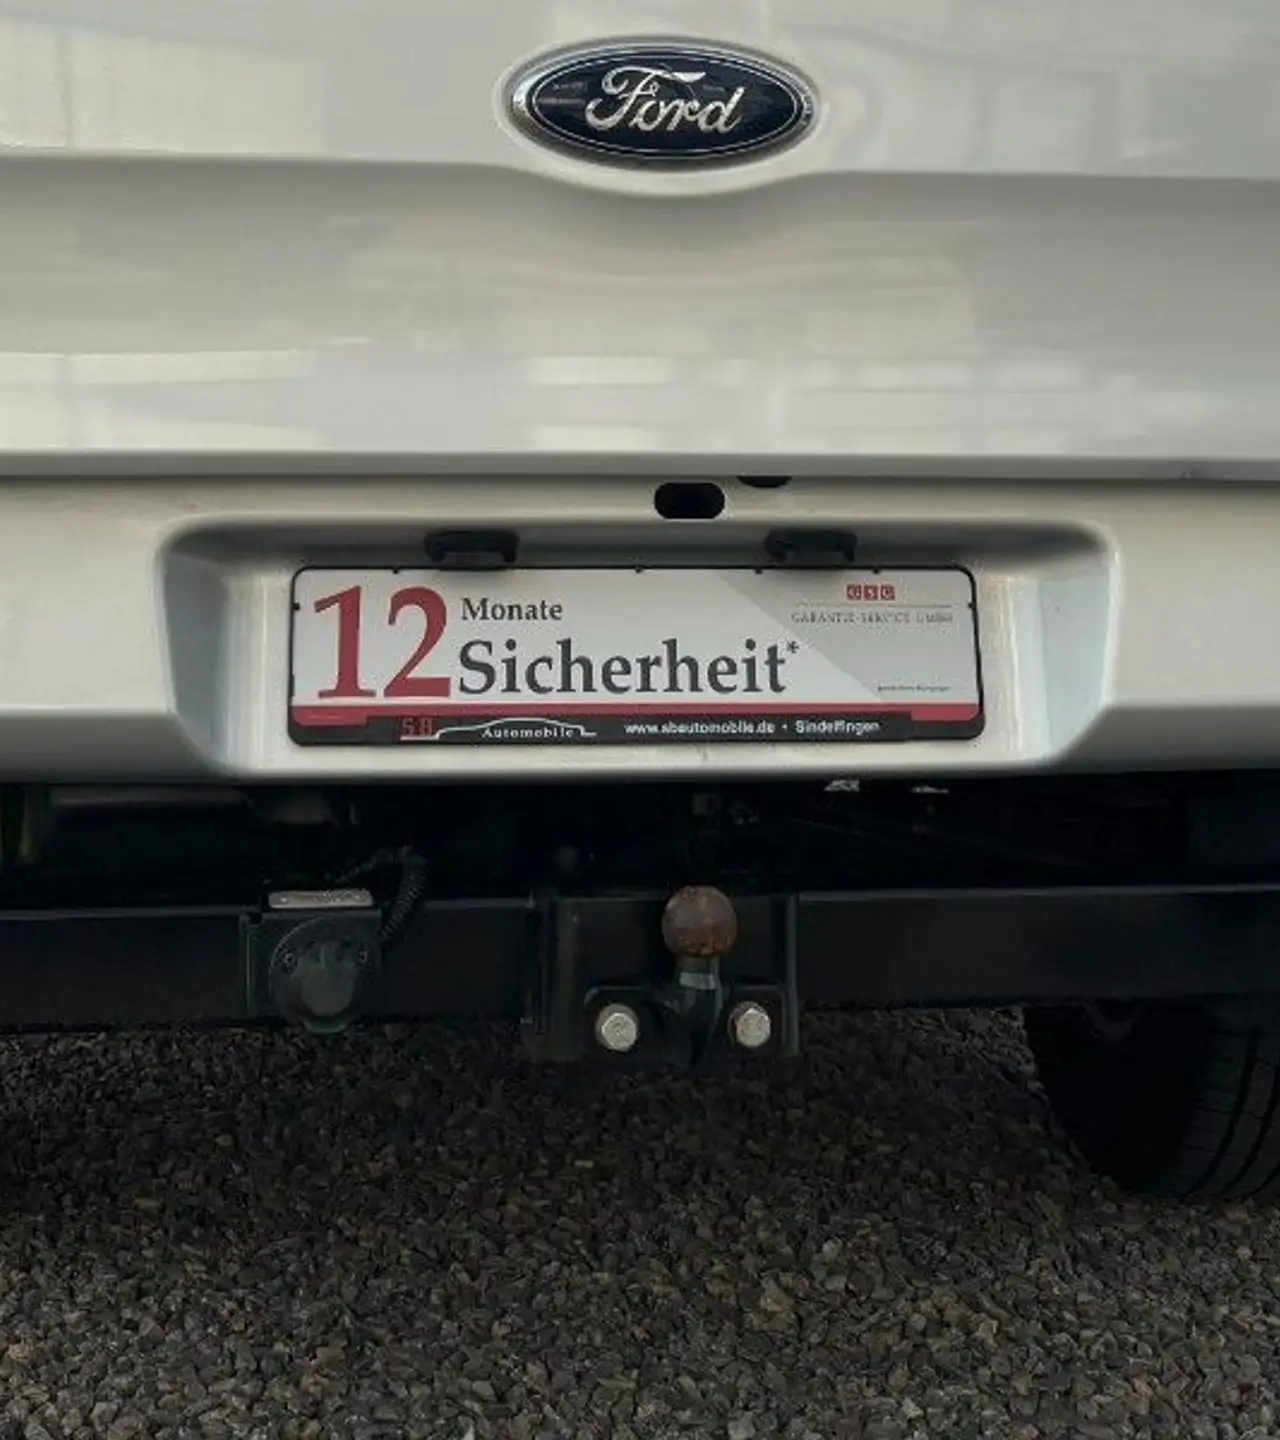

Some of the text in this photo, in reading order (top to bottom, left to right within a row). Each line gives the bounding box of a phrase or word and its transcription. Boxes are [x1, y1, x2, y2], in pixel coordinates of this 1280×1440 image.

[584, 64, 745, 134] Ford
[461, 597, 563, 621] Monate
[314, 585, 451, 698] 12
[481, 725, 575, 739] Automobile
